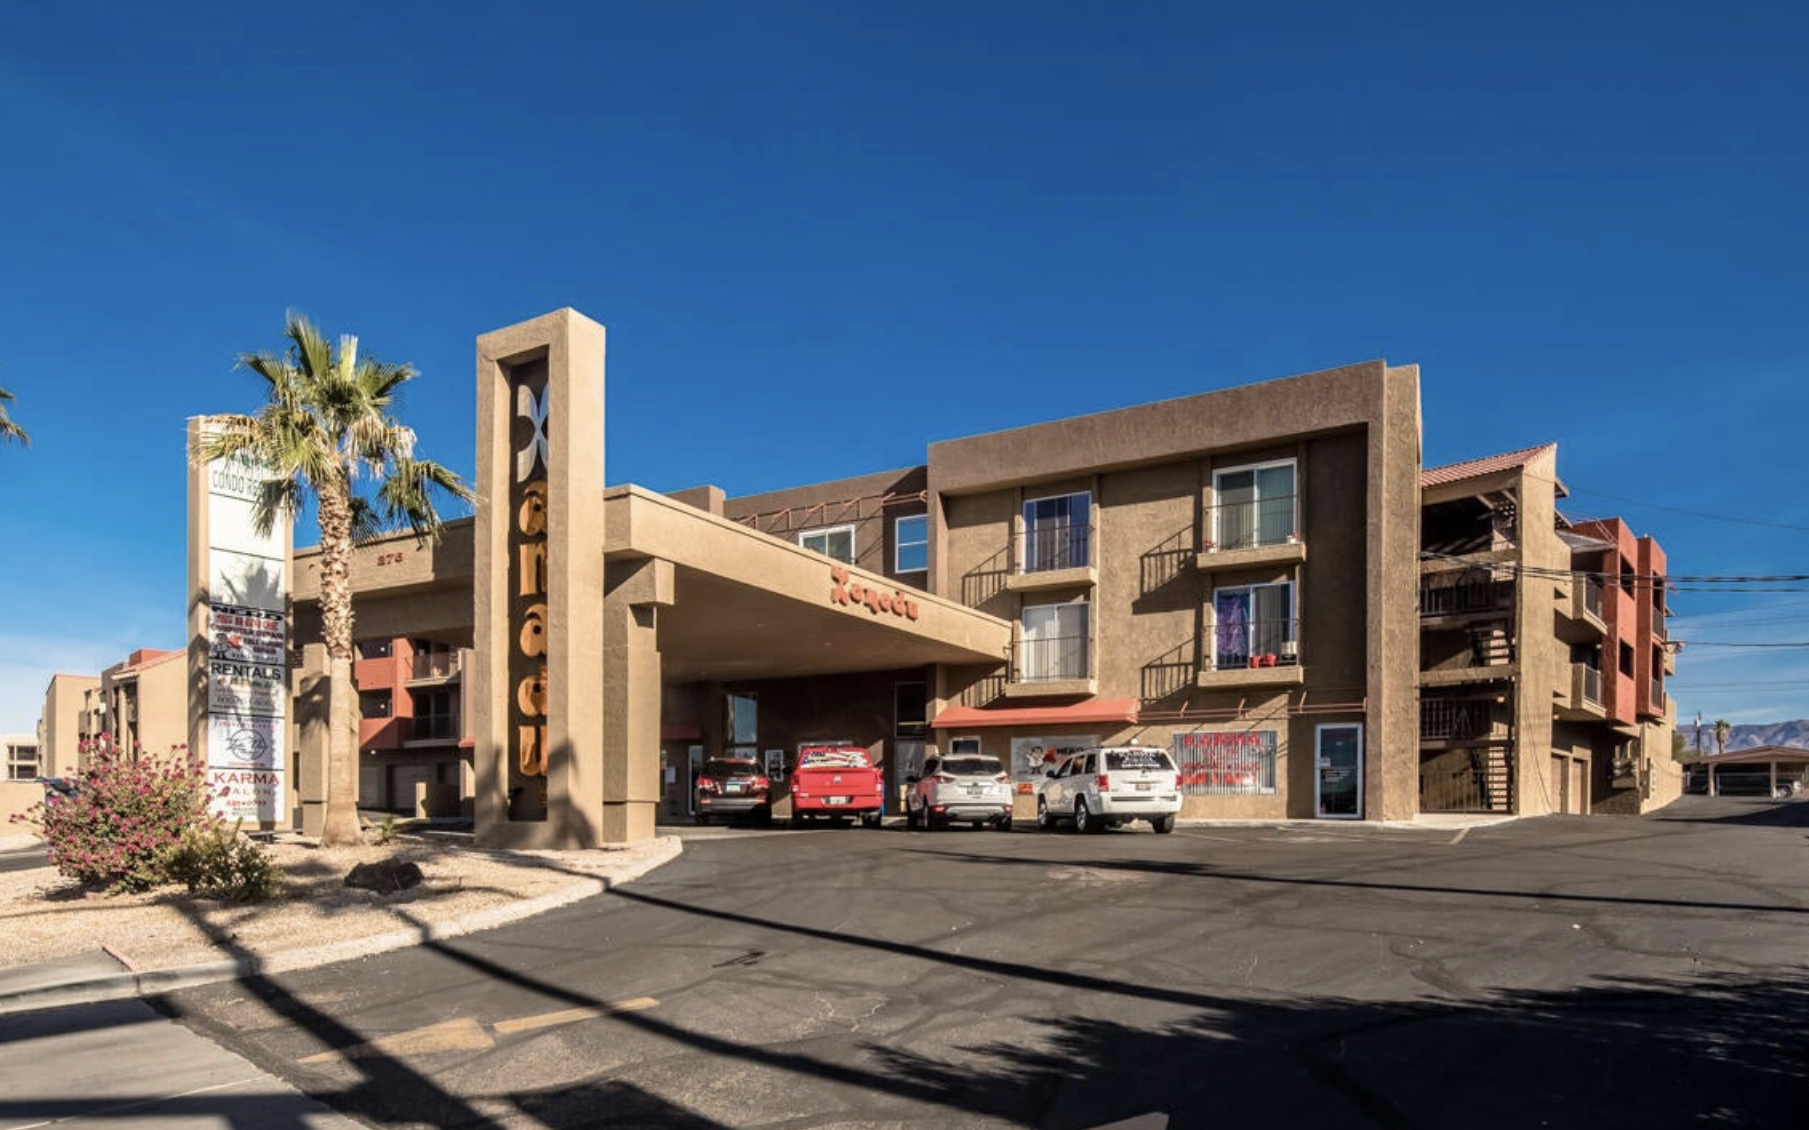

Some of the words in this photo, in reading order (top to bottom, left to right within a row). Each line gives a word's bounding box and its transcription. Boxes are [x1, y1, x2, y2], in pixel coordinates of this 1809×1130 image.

[212, 469, 245, 493] CONDO
[377, 552, 404, 566] 276
[211, 662, 281, 680] RENTALS
[1183, 732, 1261, 749] KARMA
[214, 772, 279, 785] KARMA
